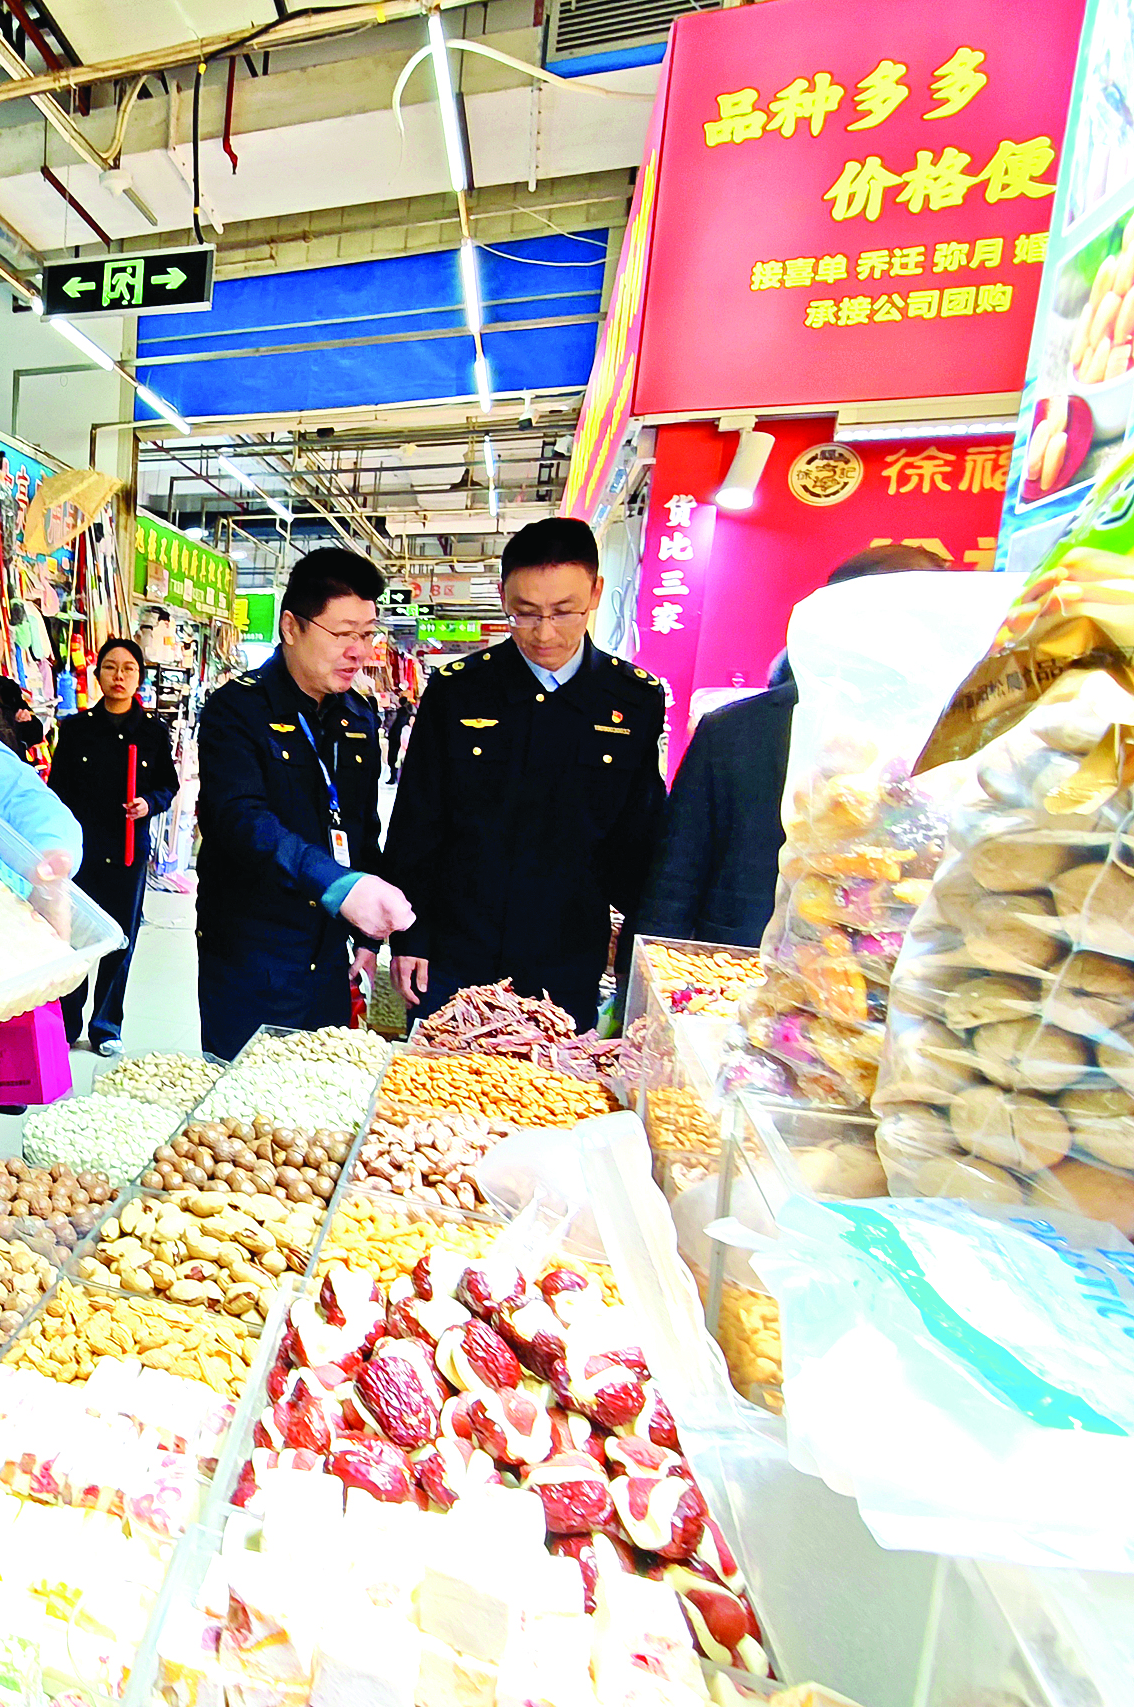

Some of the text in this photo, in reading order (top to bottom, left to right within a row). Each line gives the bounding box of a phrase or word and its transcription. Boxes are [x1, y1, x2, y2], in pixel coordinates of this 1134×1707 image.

[704, 46, 988, 147] 品种多多
[821, 136, 1057, 222] 价格便
[750, 253, 848, 291] 接喜单
[856, 245, 926, 281] 乔迁
[932, 236, 1004, 273] 弥月
[804, 282, 1014, 328] 承接公司团购
[650, 494, 698, 635] 货比三家
